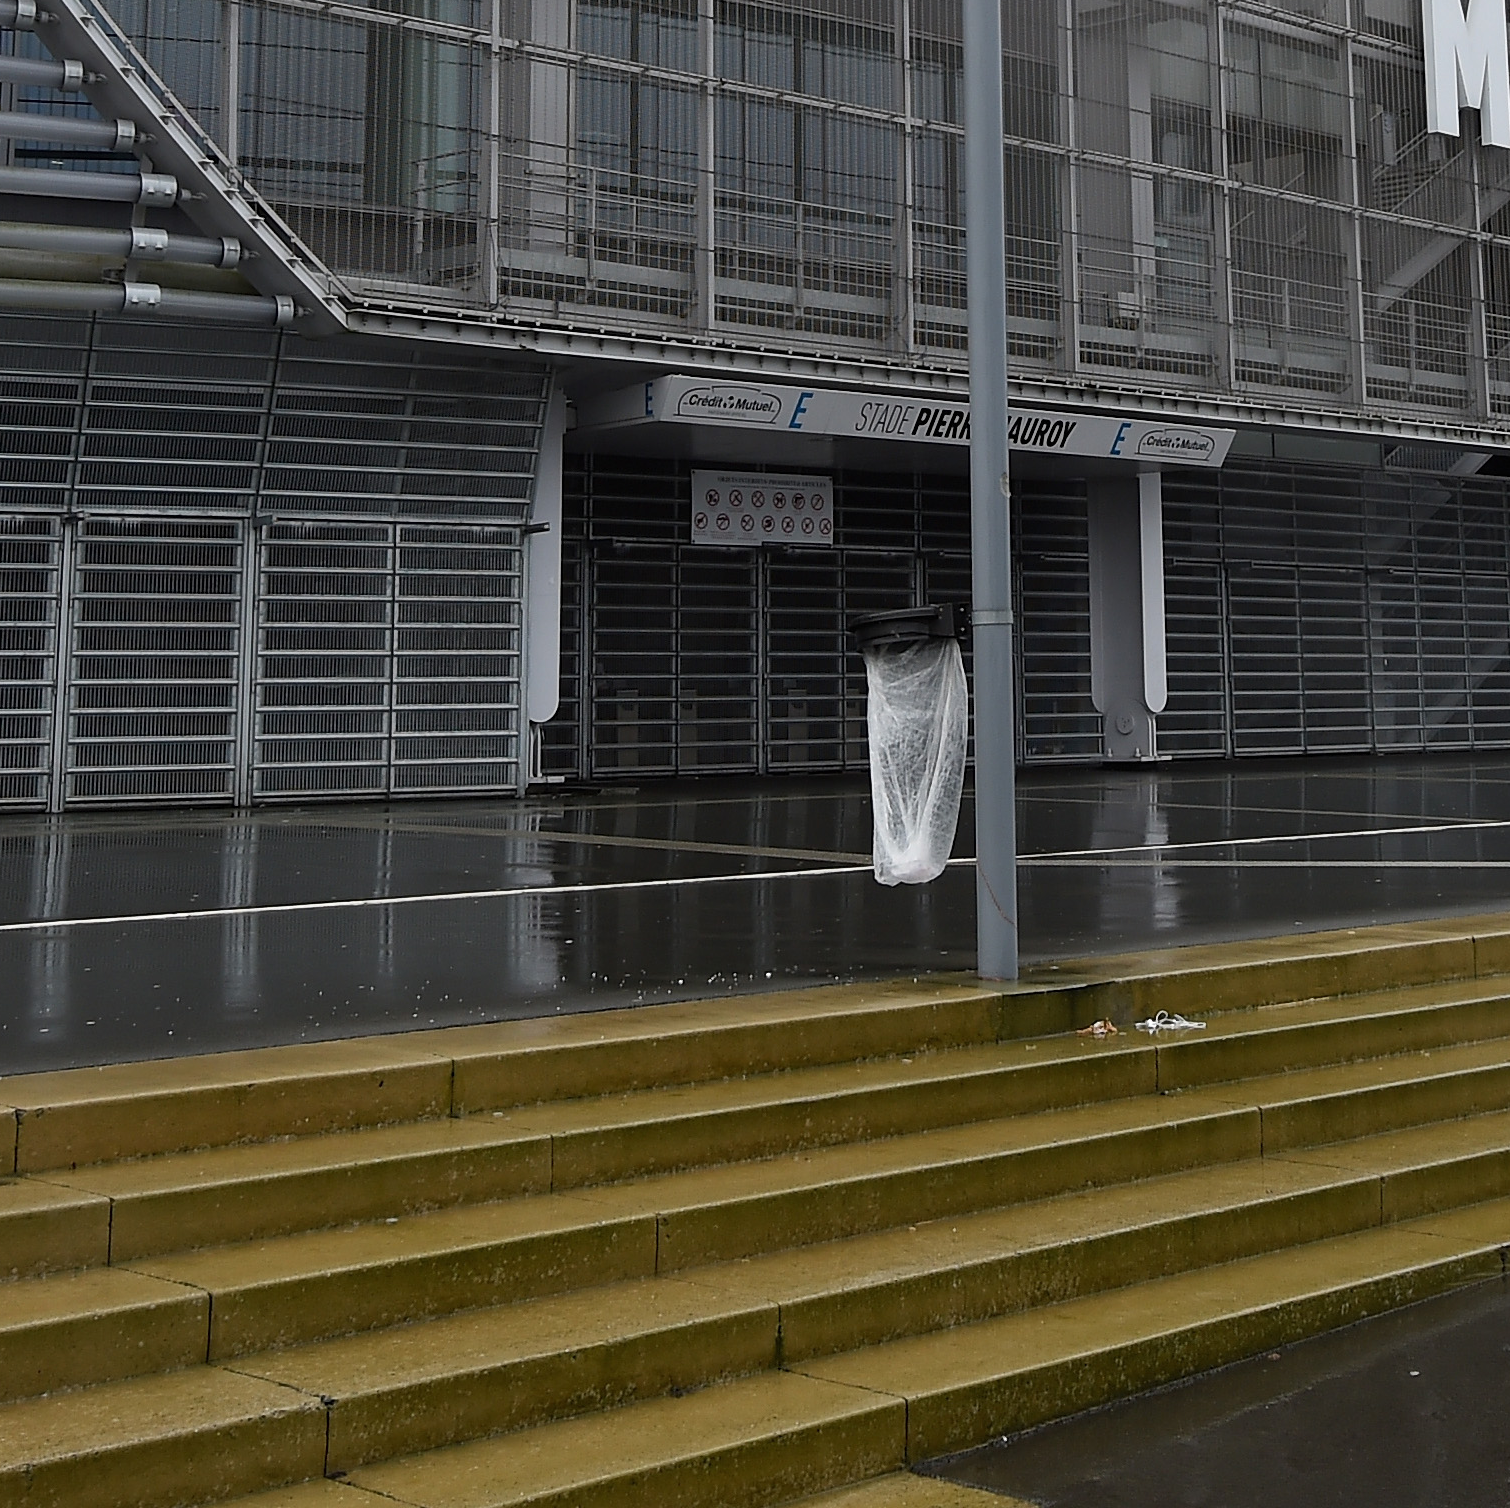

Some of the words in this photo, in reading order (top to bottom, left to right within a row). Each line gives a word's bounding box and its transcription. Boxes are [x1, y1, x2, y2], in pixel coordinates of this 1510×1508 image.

[645, 383, 654, 416] E
[689, 394, 724, 408] Crédit
[735, 398, 773, 412] Mutuel
[789, 392, 814, 428] E
[855, 402, 915, 434] STADE
[912, 407, 971, 441] PIERR
[1008, 415, 1077, 449] AUROY
[1110, 423, 1132, 455] E
[1146, 435, 1173, 449] Crédit
[1181, 438, 1209, 452] Mutuel
